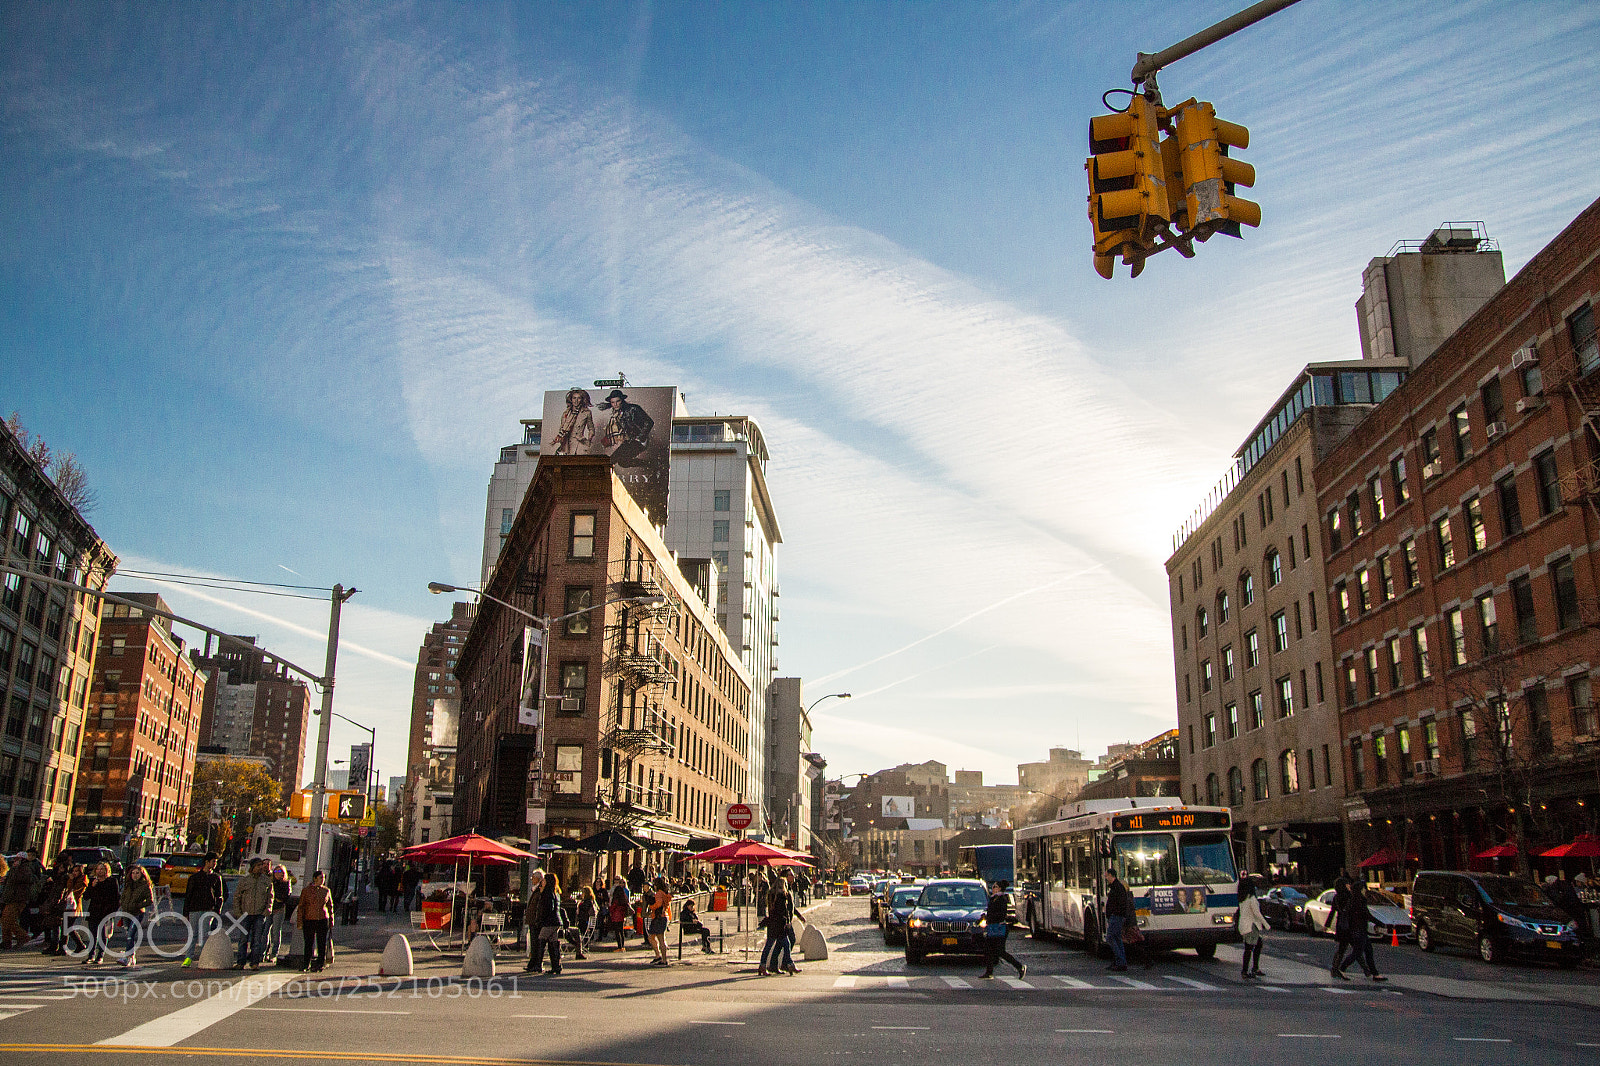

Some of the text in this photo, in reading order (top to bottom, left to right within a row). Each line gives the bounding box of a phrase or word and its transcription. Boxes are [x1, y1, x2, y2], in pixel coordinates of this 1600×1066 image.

[563, 773, 572, 781] ST
[1171, 814, 1182, 826] 10
[1183, 814, 1195, 826] AV
